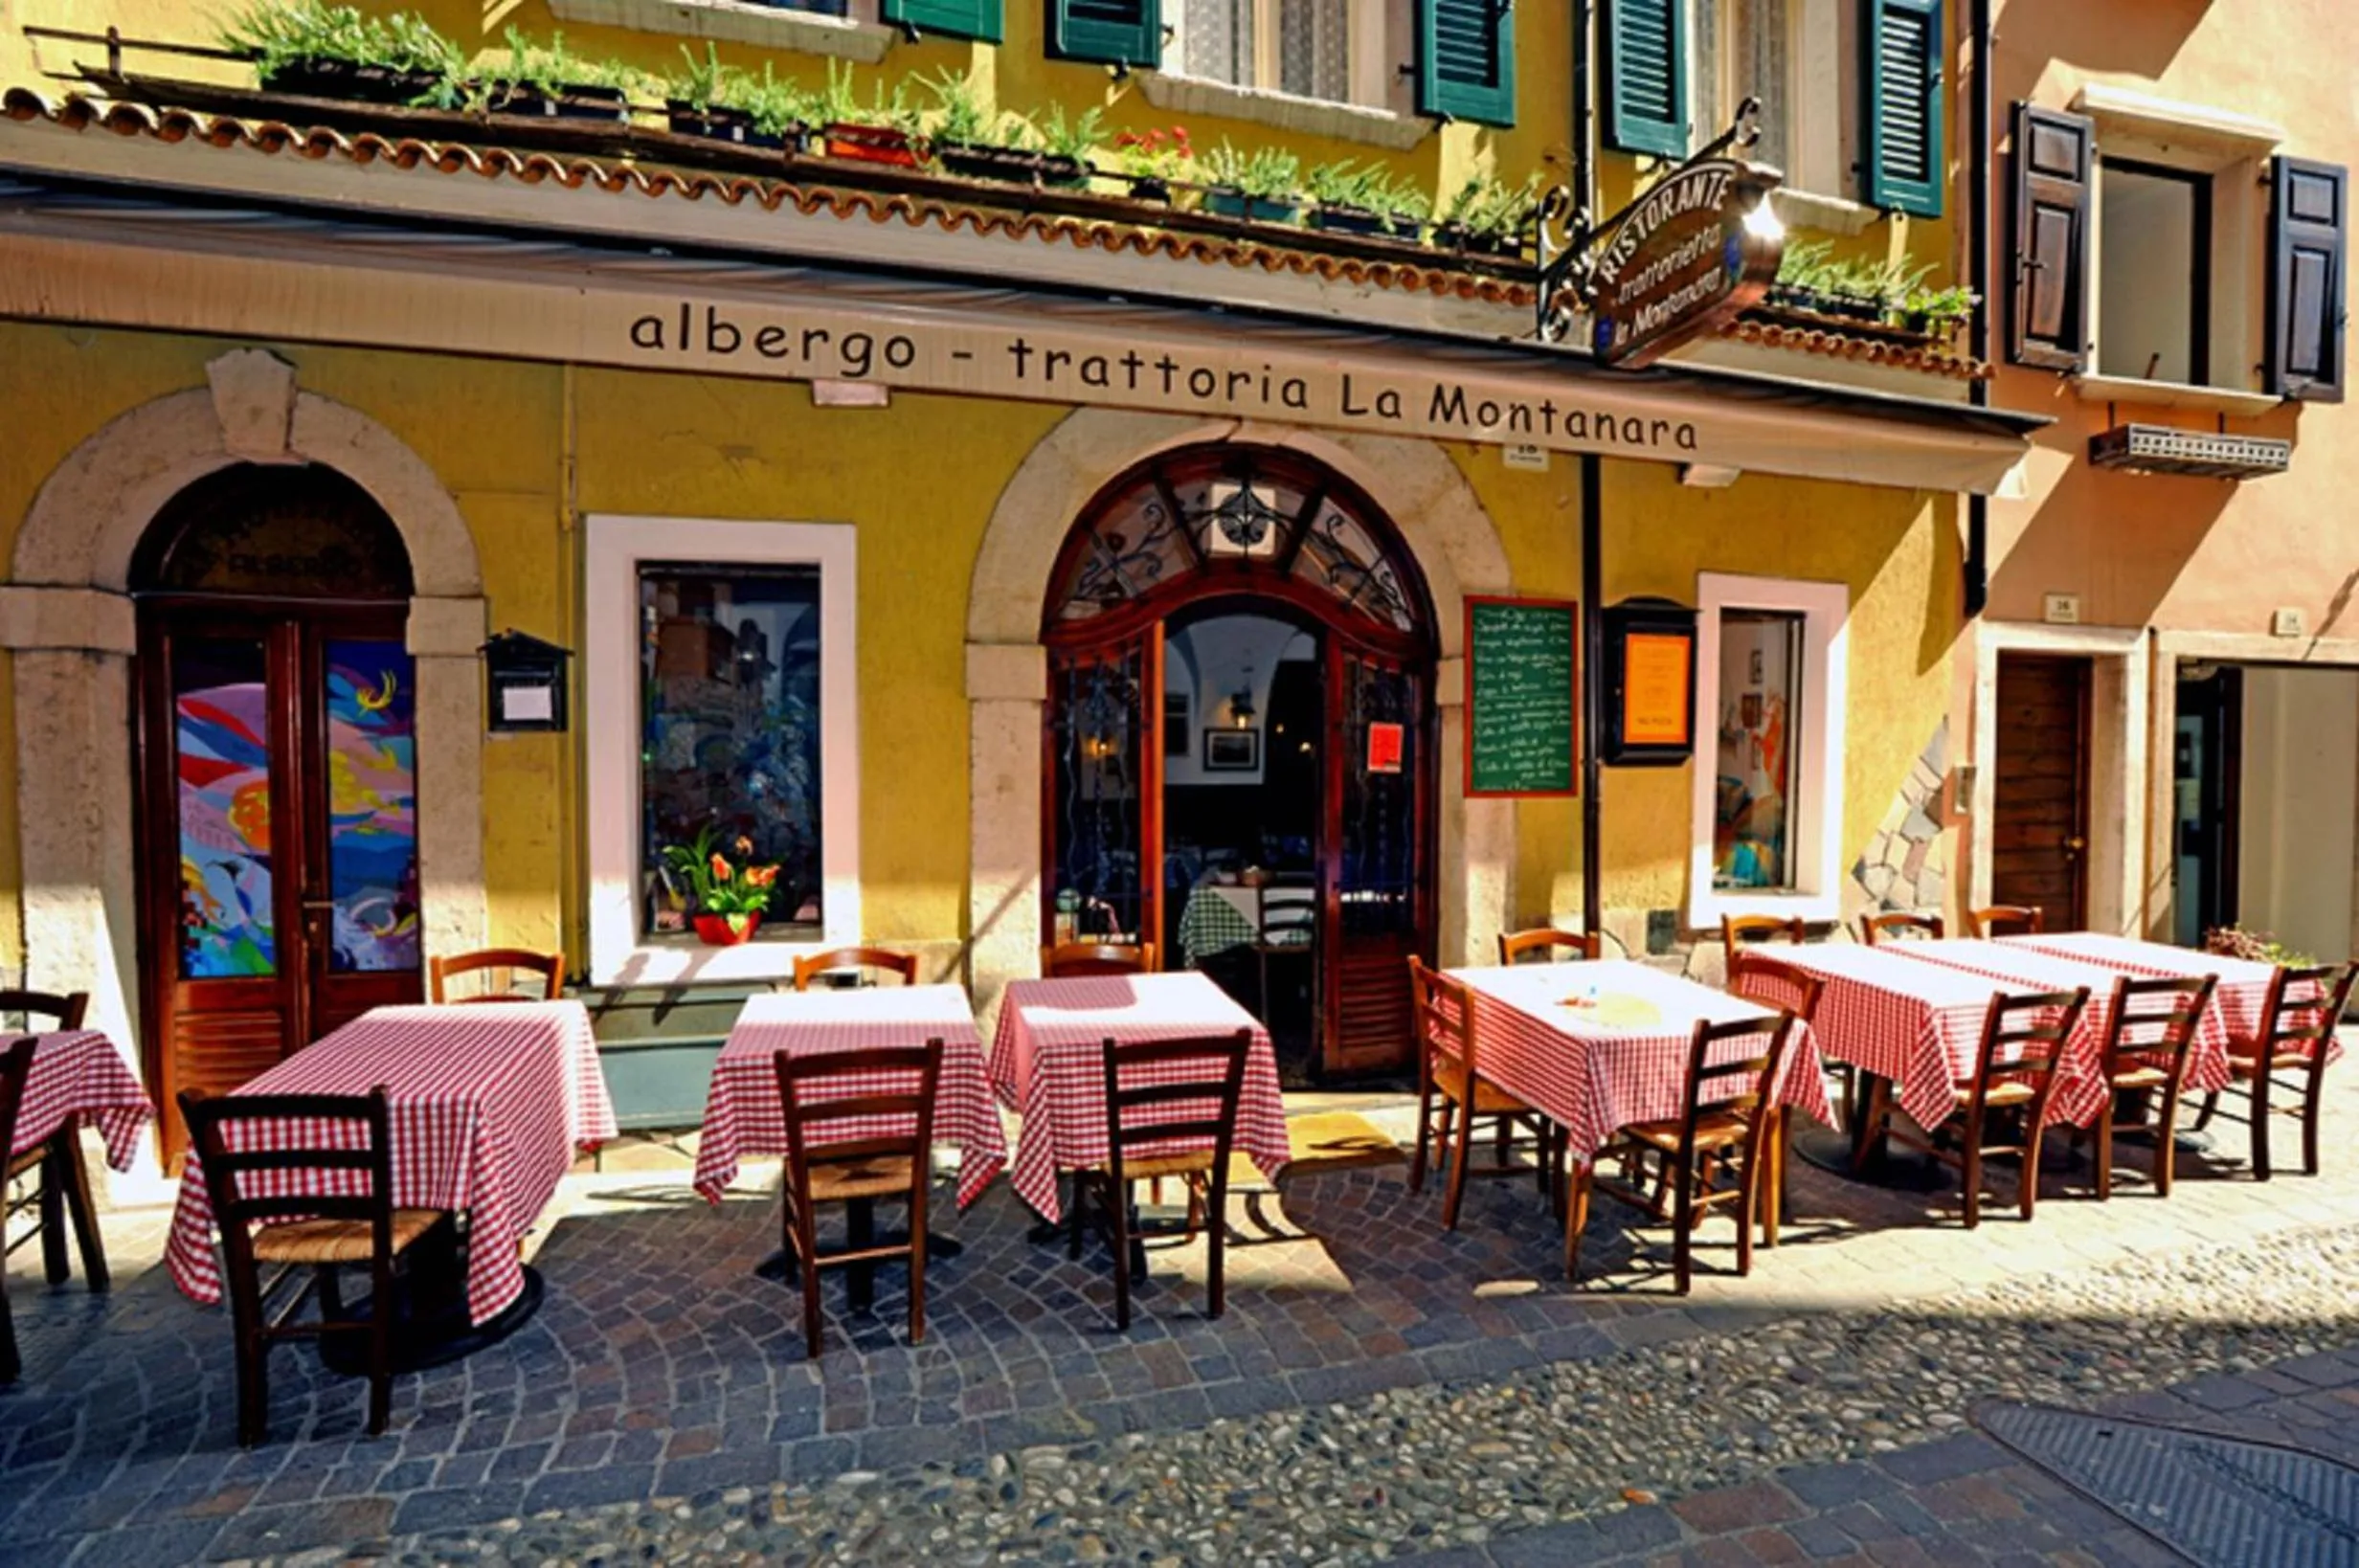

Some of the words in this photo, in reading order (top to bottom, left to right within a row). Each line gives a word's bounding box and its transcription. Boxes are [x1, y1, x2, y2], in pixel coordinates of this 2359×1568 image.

[1600, 170, 1732, 284] RISTORANTE
[1631, 266, 1721, 338] Montanara
[630, 302, 916, 378] albergo
[1007, 337, 1309, 410] trattoria
[1342, 373, 1402, 418] La
[1428, 384, 1697, 450] Montanara
